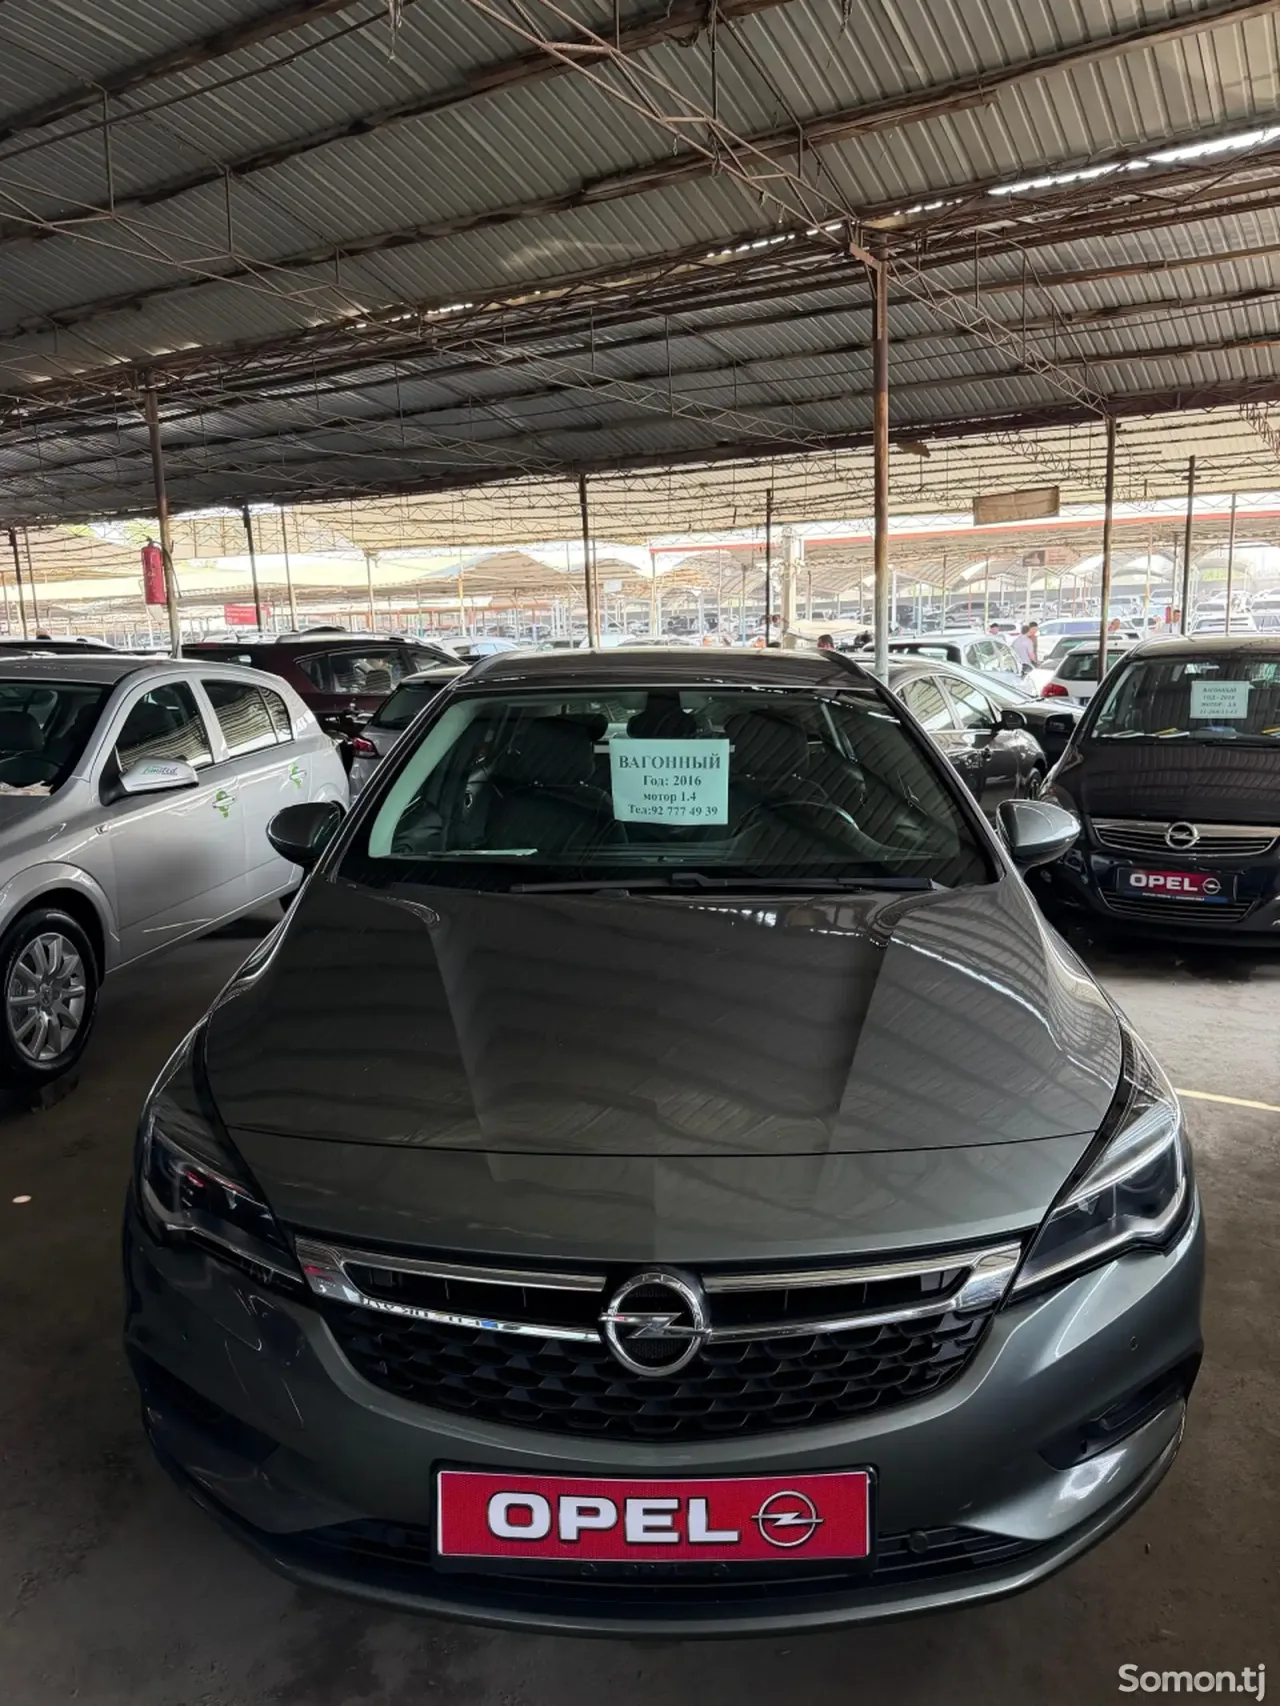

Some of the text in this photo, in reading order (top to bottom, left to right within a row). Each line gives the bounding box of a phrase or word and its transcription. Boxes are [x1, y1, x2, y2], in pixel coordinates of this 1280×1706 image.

[619, 753, 721, 769] ВАГОННЫЙ
[643, 775, 701, 786] Год: 2016
[643, 792, 697, 804] мотор 1.4
[667, 806, 686, 816] 777
[689, 806, 702, 816] 49
[705, 806, 718, 816] 39
[1129, 873, 1198, 891] OPEL
[487, 1492, 740, 1543] OPEL
